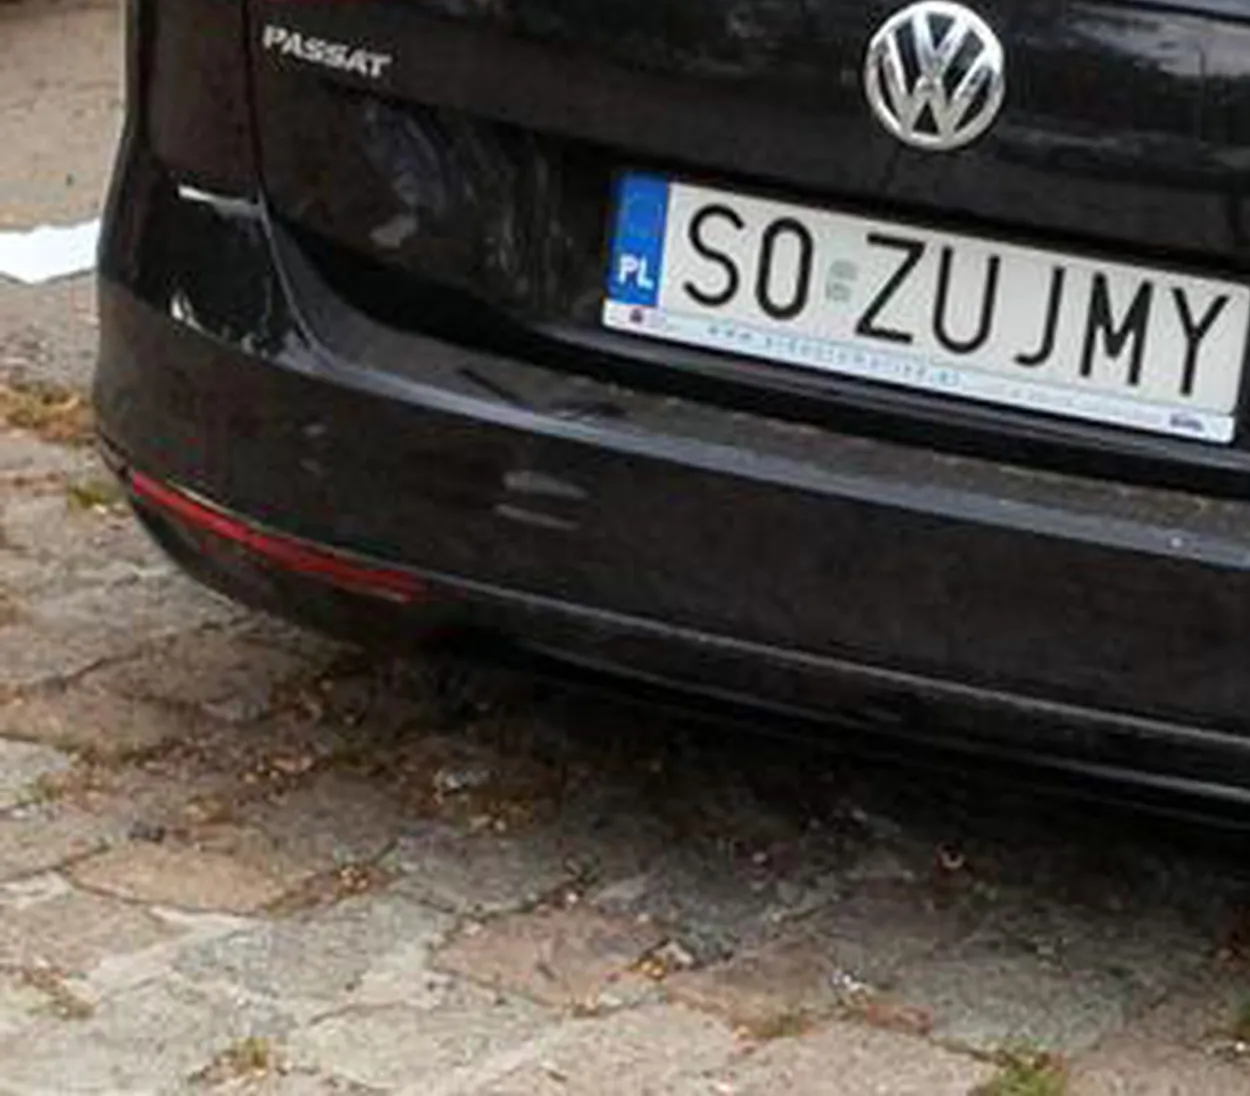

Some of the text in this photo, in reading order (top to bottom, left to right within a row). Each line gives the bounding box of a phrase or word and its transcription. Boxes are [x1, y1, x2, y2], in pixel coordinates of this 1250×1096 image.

[263, 24, 393, 77] PASSAT
[618, 254, 653, 289] PL
[855, 233, 1228, 396] ZUJMY
